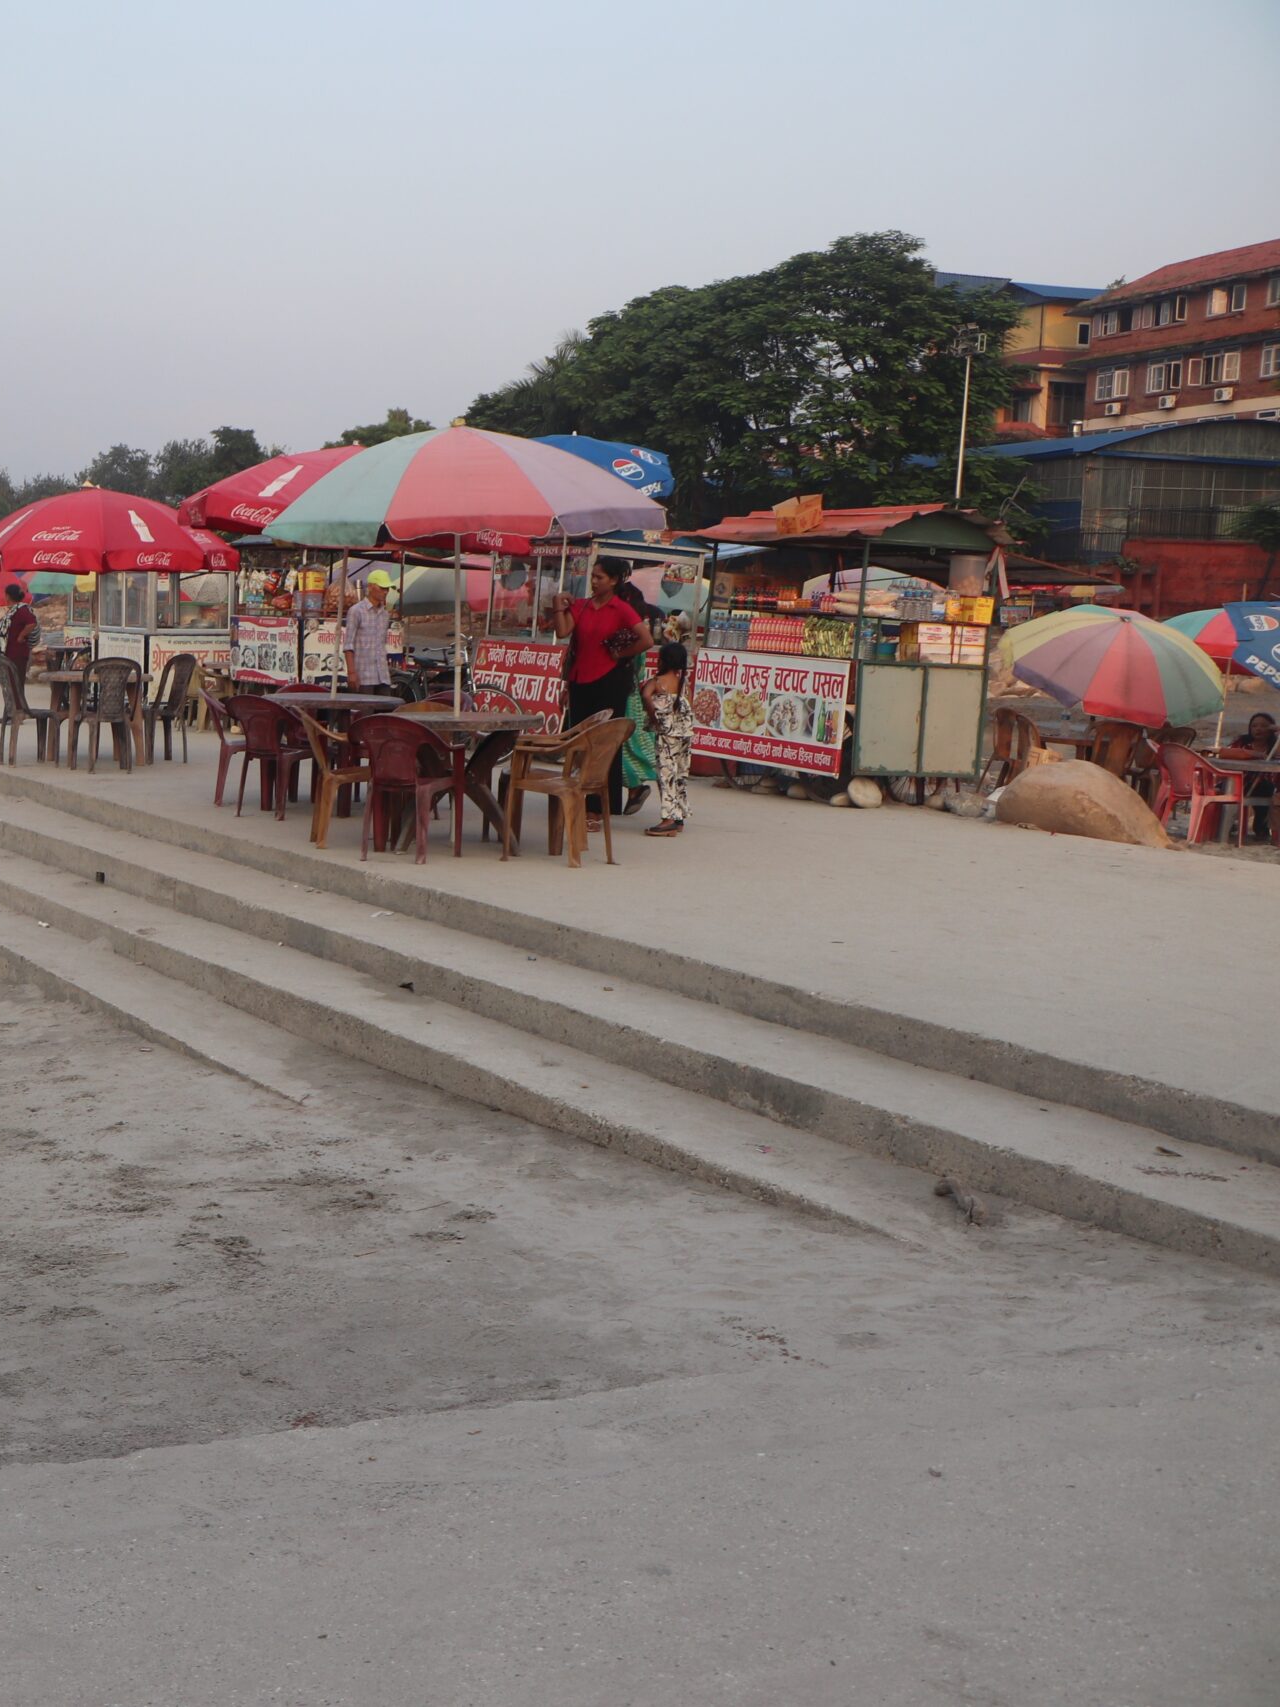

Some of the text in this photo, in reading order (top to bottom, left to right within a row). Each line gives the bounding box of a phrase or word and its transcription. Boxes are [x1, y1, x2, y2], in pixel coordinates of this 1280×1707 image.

[32, 530, 82, 541] Coca-Cola
[33, 551, 75, 566] Coca-Cola
[696, 653, 739, 686] गोर्खाली
[774, 667, 810, 694] चटपट
[812, 671, 846, 699] पसल
[511, 673, 546, 702] खाजा
